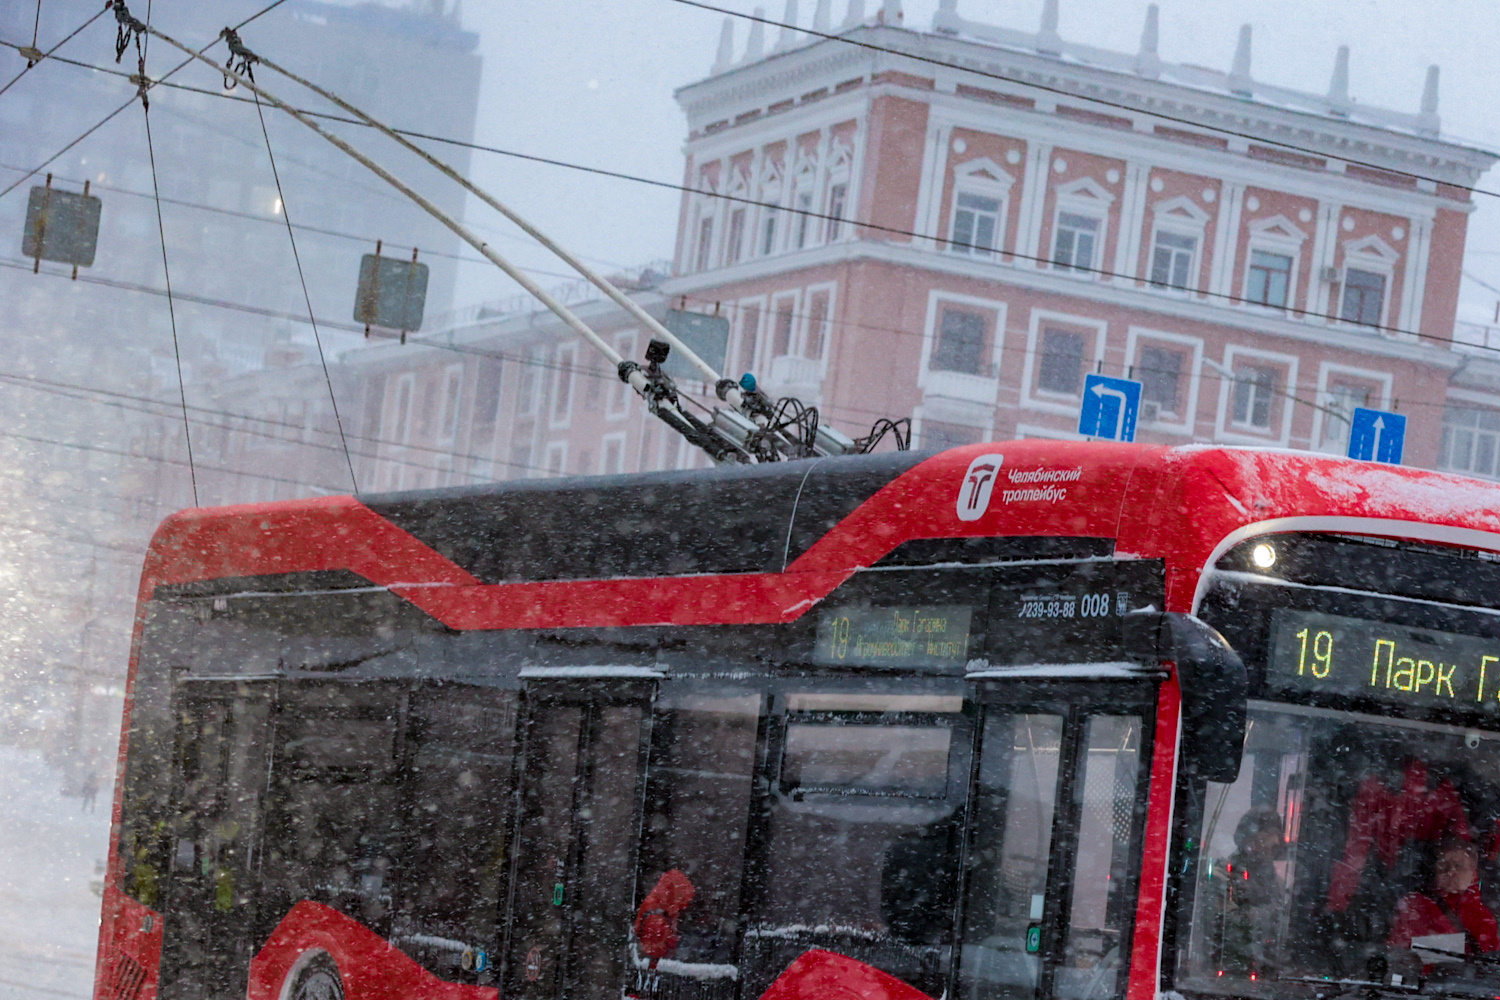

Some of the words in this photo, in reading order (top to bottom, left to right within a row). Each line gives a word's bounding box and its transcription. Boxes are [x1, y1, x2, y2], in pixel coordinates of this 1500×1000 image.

[1008, 466, 1083, 484] Челябинский
[1002, 485, 1067, 504] троллейбус
[1025, 602, 1076, 618] 239-93-88
[1081, 593, 1110, 617] 008
[1296, 628, 1334, 679] 19
[1371, 639, 1457, 698] Парк
